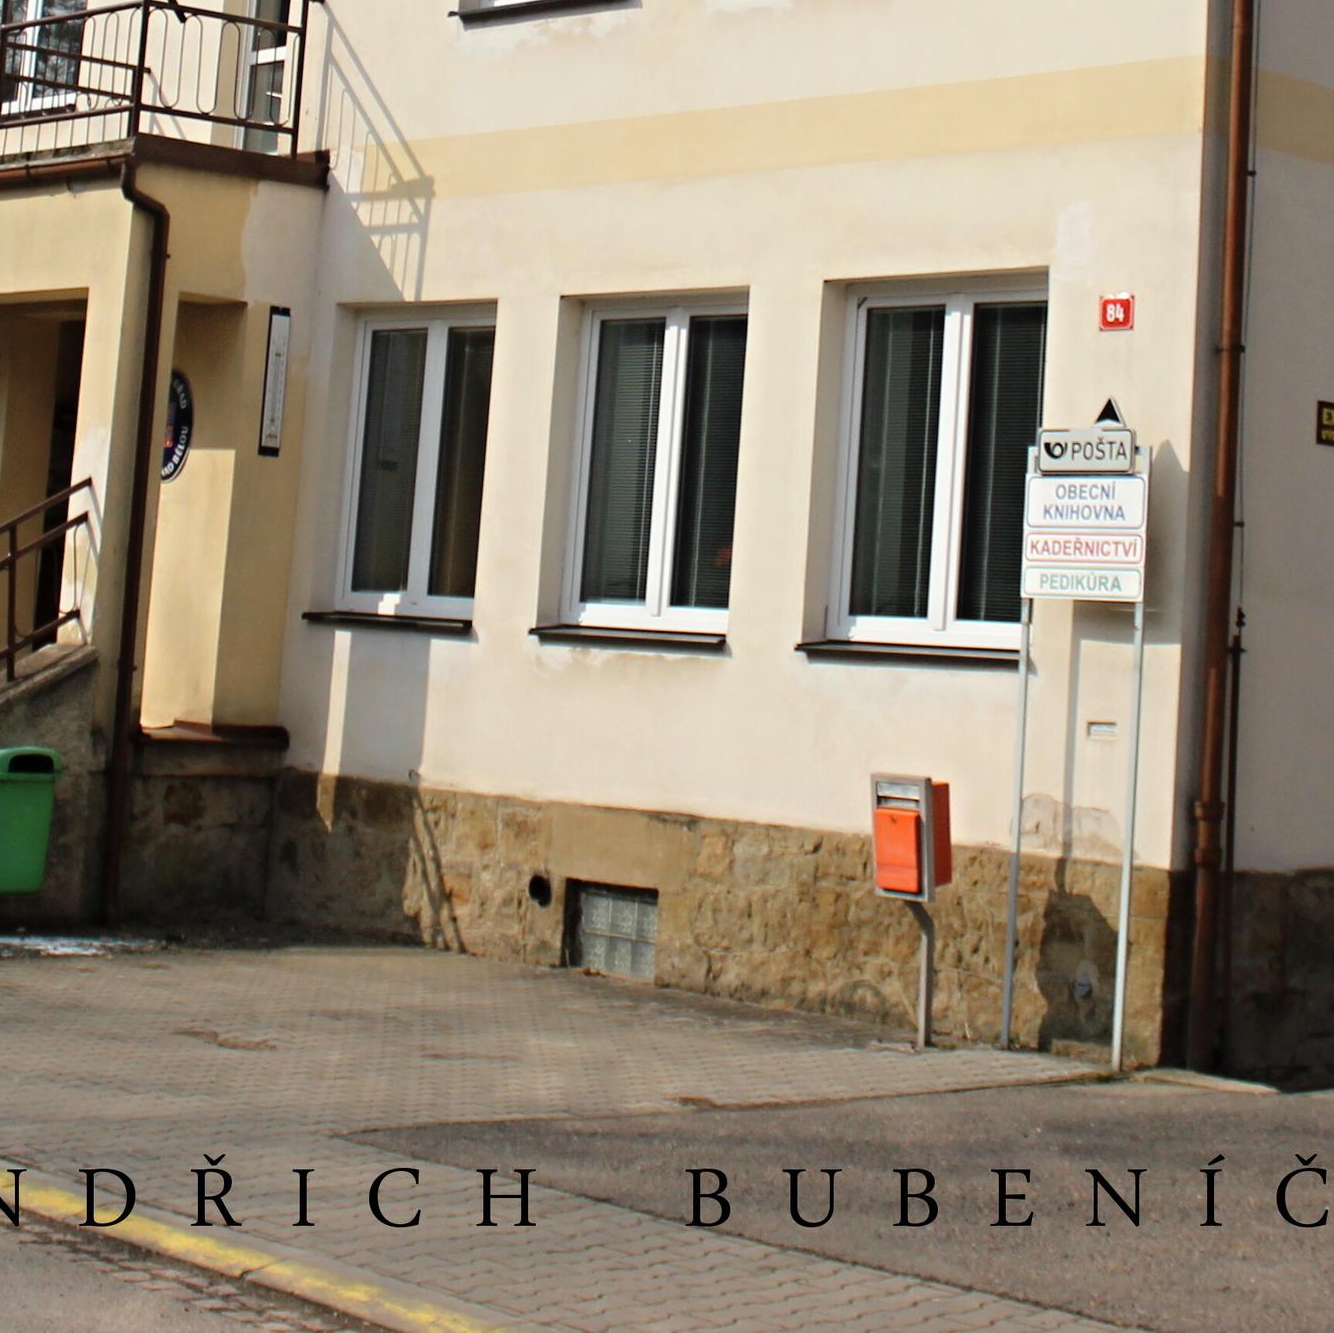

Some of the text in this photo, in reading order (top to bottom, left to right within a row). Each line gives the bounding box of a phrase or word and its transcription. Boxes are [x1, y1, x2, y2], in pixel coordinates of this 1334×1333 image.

[1106, 303, 1124, 323] 84
[1071, 436, 1128, 461] POŠTA
[1055, 481, 1116, 501] OBECNÍ
[1043, 504, 1126, 521] KNIHOVNA
[1030, 537, 1138, 557] KADEŘNICTVÍ
[1039, 569, 1122, 592] PEDIKÚRA
